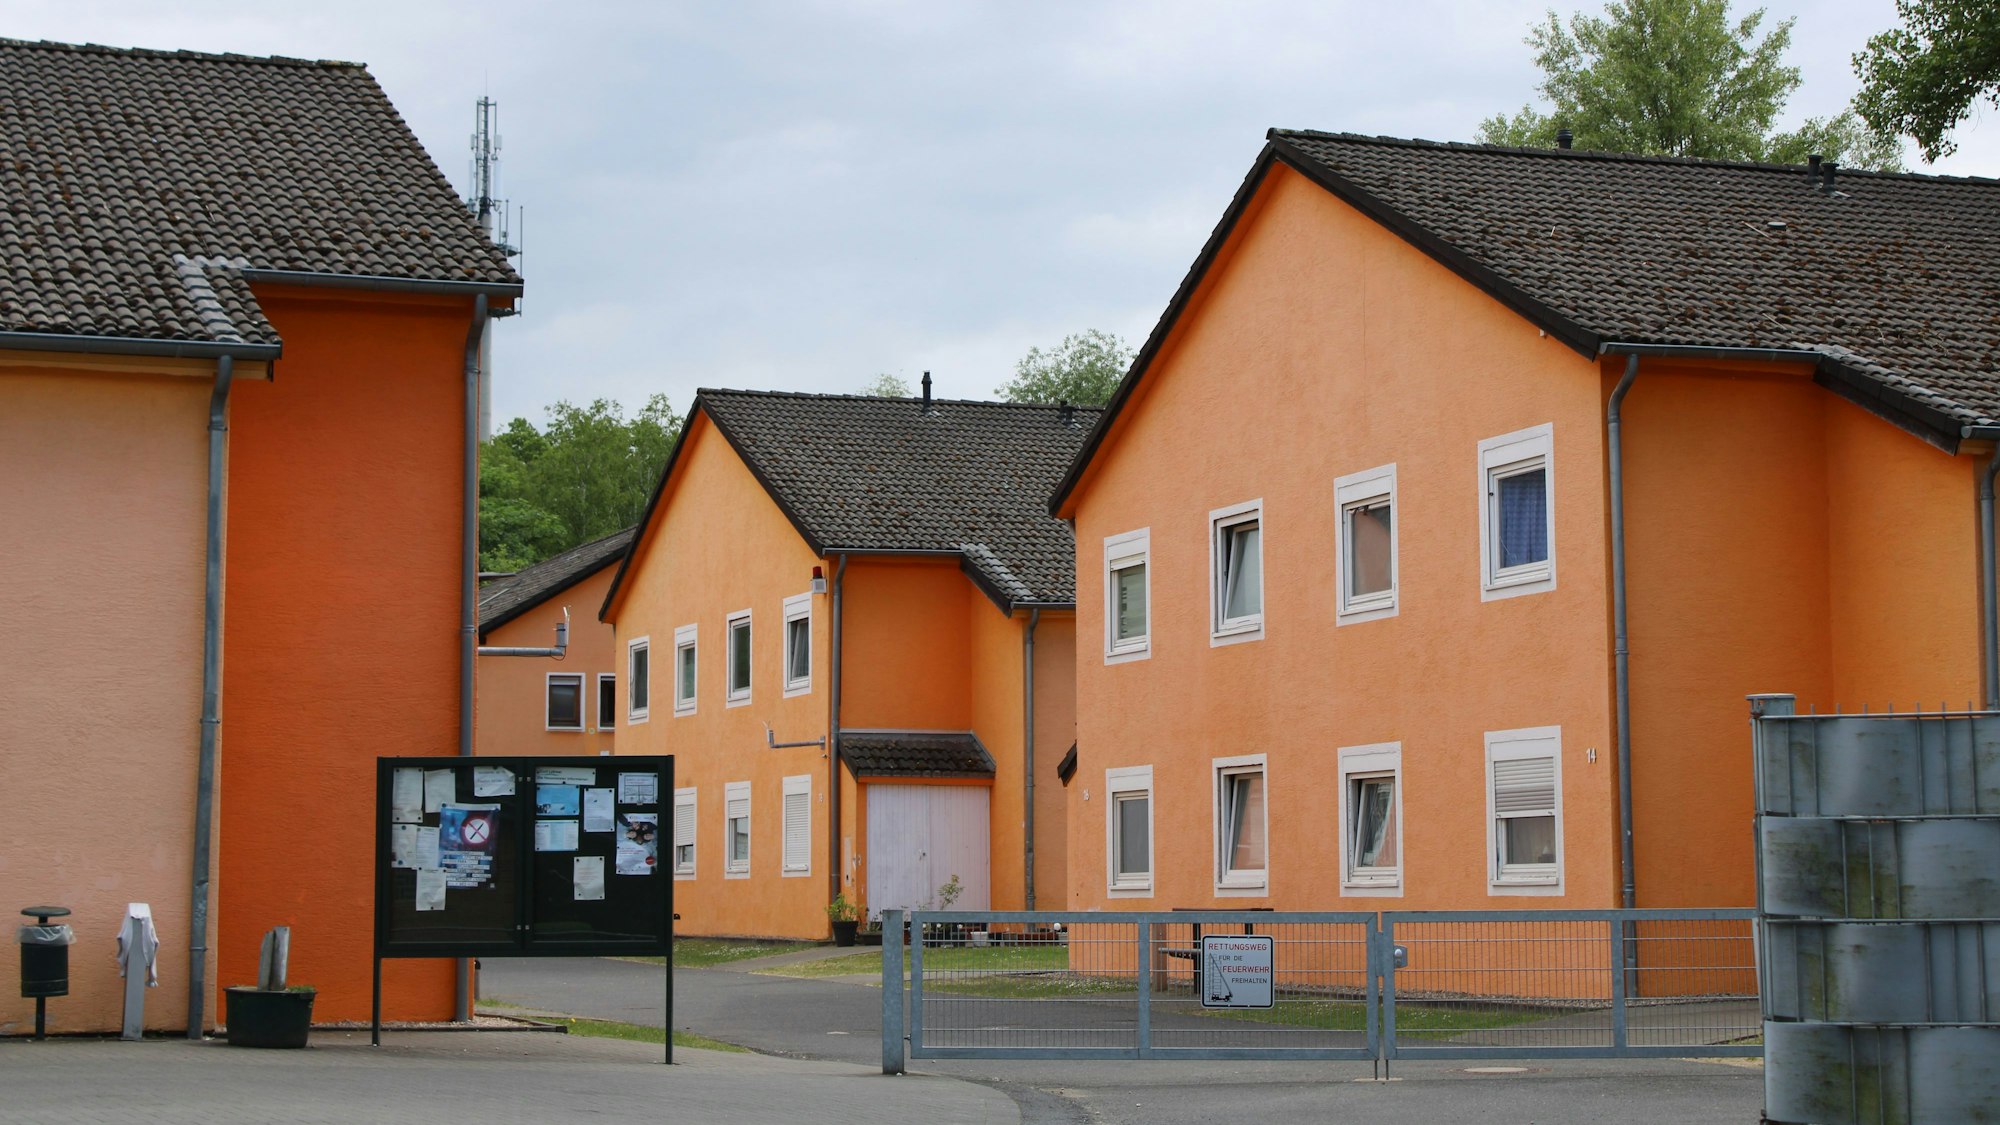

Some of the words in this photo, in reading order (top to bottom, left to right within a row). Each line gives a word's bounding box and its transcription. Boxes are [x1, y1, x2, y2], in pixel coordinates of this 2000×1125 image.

[1586, 747, 1596, 764] 14
[1208, 943, 1268, 951] RETTUNGSWEG
[1222, 965, 1270, 973] FEUERWEHR
